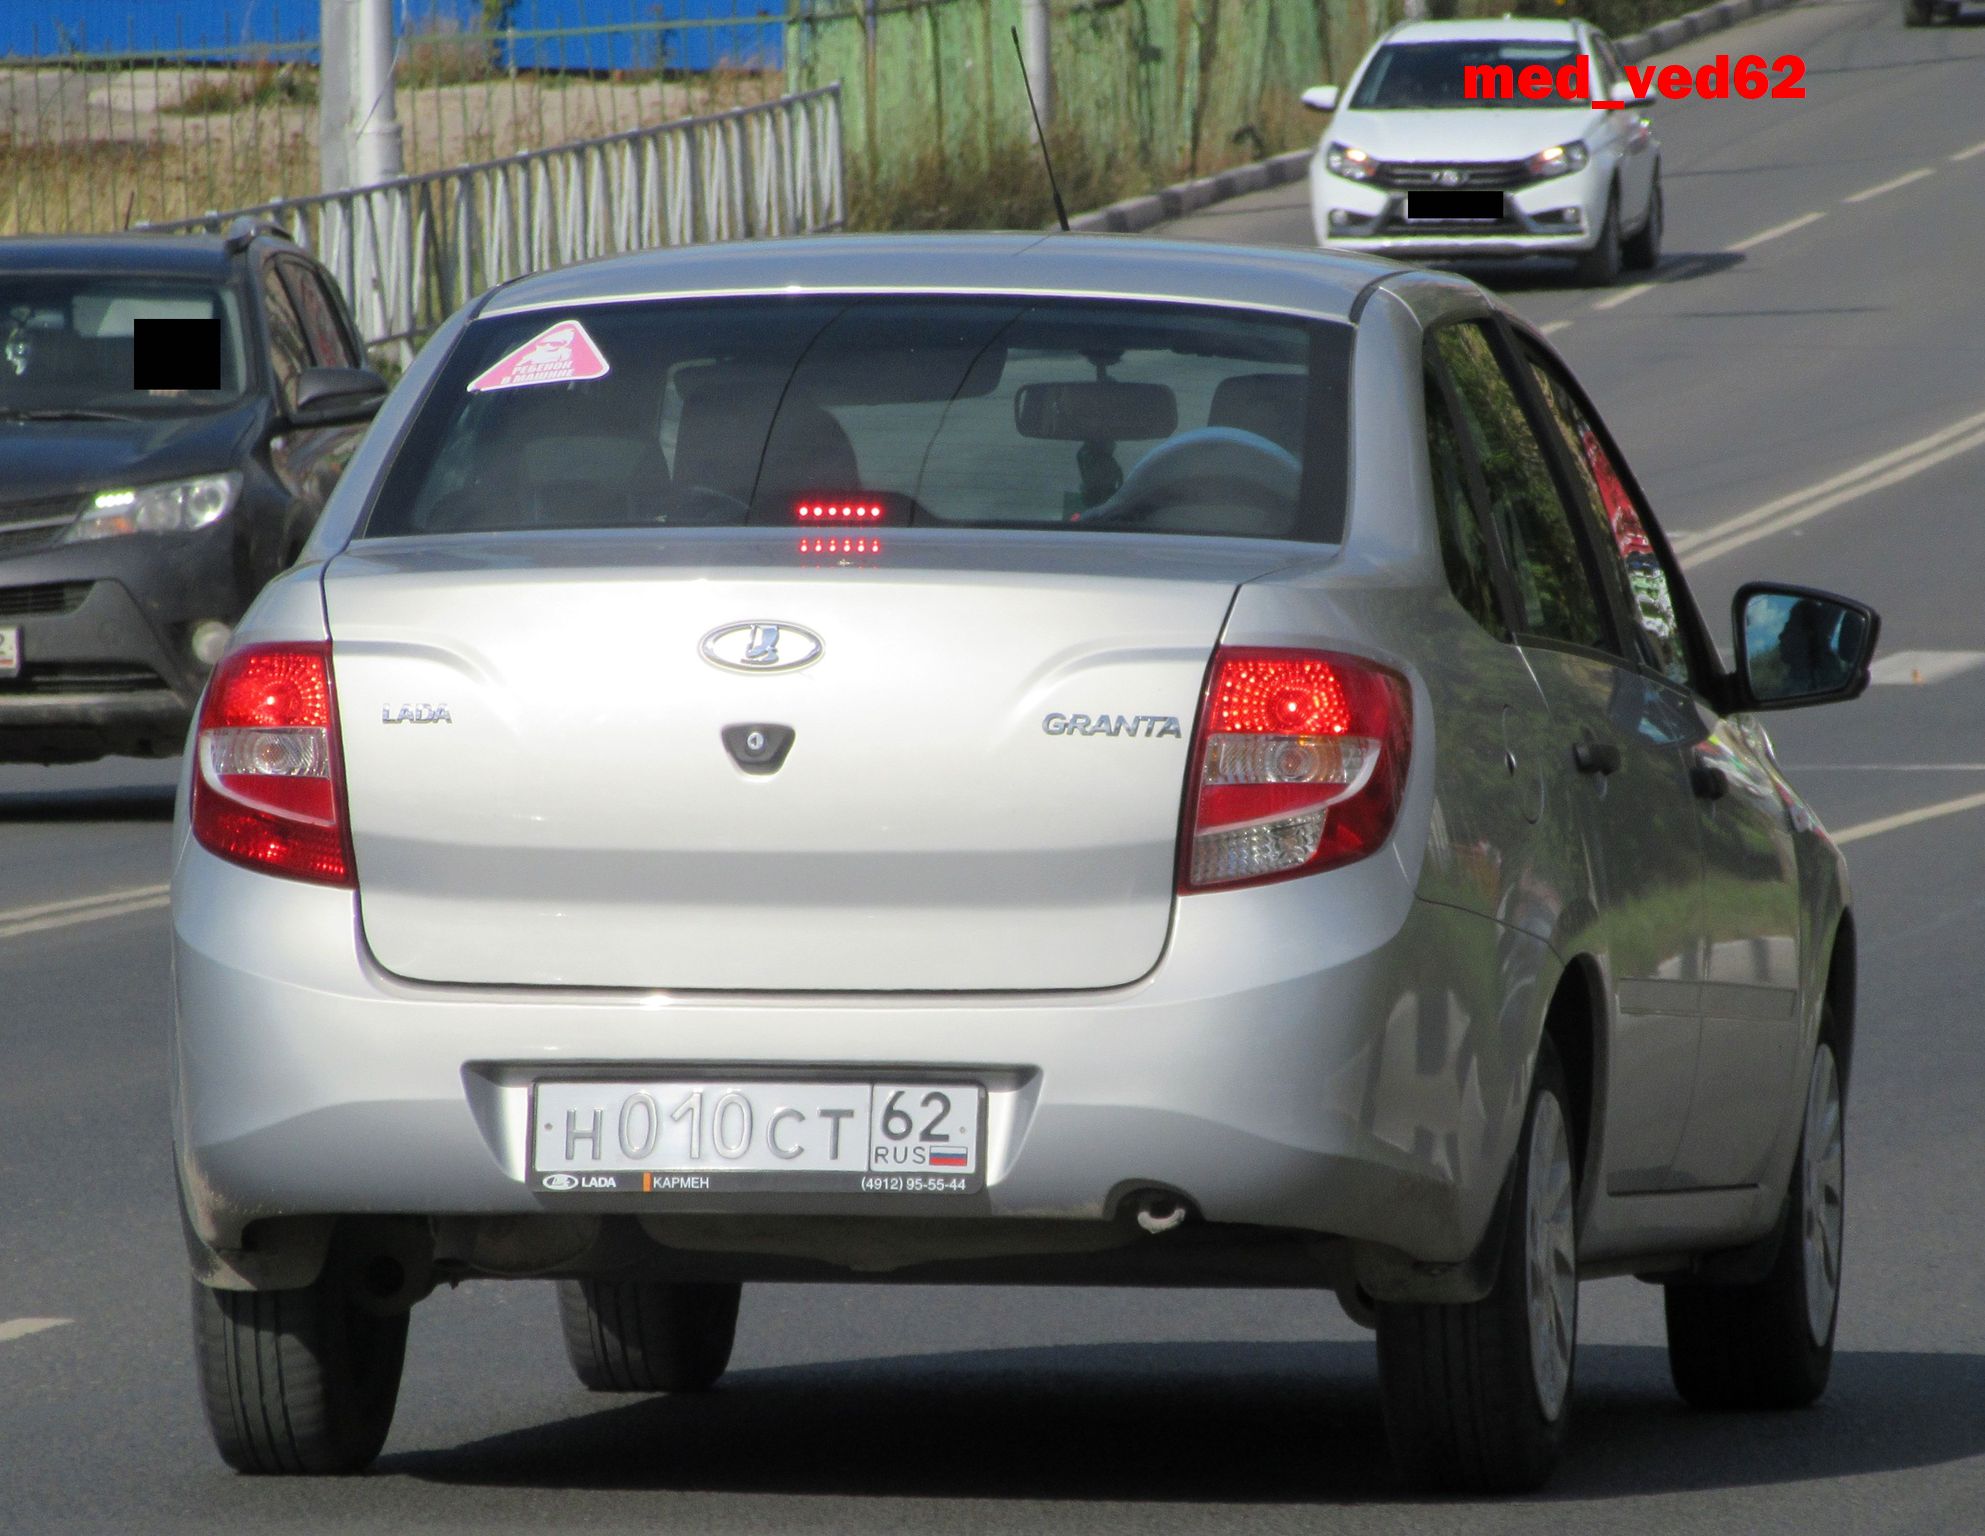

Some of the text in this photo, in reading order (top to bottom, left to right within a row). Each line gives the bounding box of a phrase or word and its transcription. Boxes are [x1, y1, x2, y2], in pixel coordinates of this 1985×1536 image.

[382, 703, 452, 724] LADA
[1042, 712, 1182, 739] GRANTA
[881, 1090, 951, 1142] 62
[875, 1146, 926, 1164] RUS
[581, 1177, 616, 1188] LADA
[653, 1177, 709, 1189] КАРМЕН
[861, 1177, 966, 1191] (4912) 95-55-44
